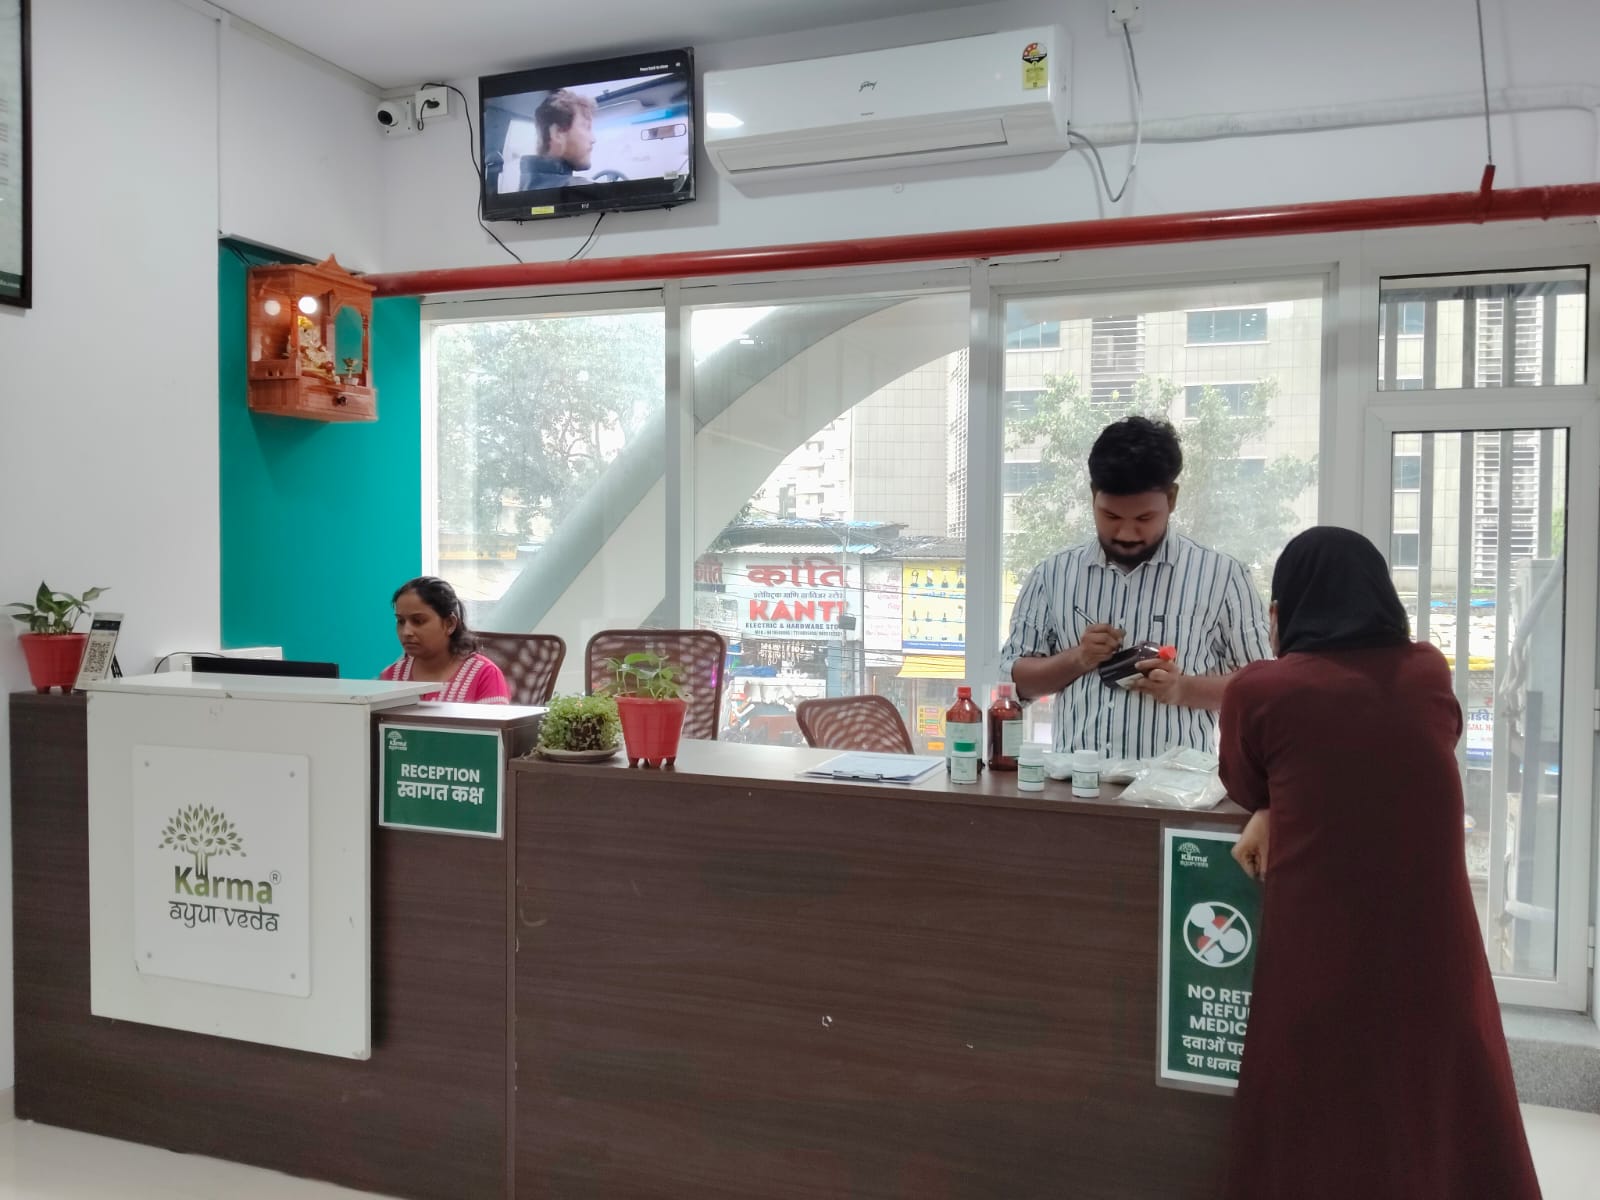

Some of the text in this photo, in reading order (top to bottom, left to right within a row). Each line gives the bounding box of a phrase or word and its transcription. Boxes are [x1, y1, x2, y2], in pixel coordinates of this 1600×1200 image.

[746, 556, 851, 587] कांति
[749, 600, 848, 622] KANTI
[401, 763, 480, 783] RECEPTION
[397, 780, 485, 805] स्वागत कक्ष
[175, 865, 273, 904] Karma
[168, 901, 280, 931] ayurveda
[1188, 984, 1252, 1005] NO RET
[1202, 1001, 1250, 1020] REFU
[1190, 1015, 1247, 1036] MEDIC
[1182, 1034, 1226, 1053] दवाओं
[1186, 1053, 1204, 1068] या
